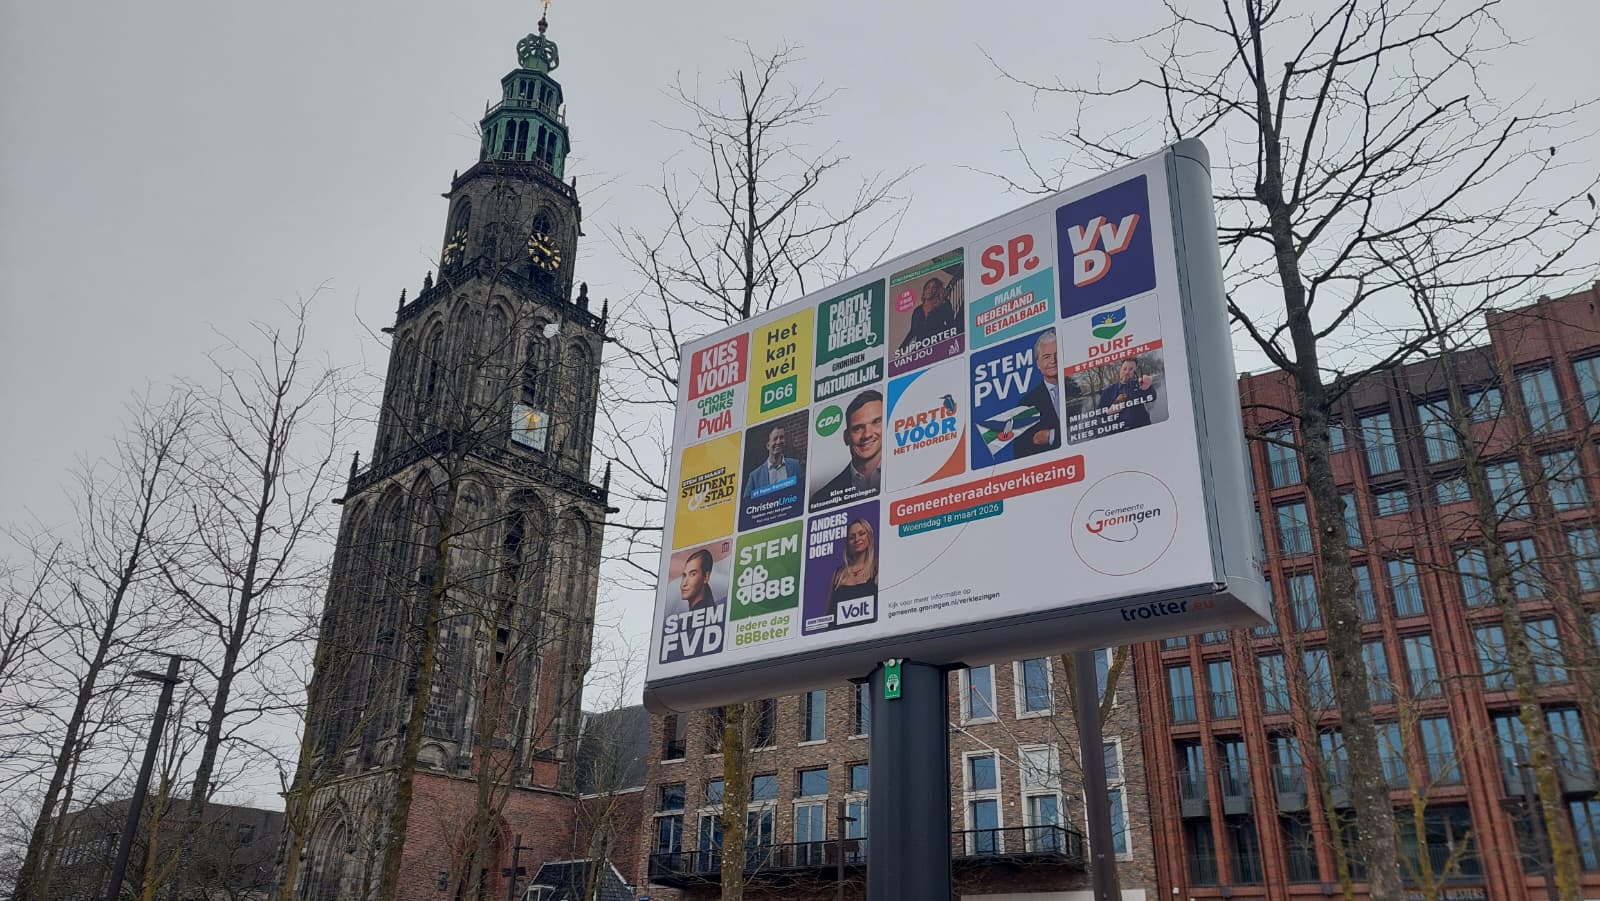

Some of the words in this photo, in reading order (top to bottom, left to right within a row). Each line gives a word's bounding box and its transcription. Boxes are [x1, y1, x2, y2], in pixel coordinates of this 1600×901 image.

[829, 289, 872, 321] PARTIJ
[994, 285, 1022, 306] MAAK
[829, 312, 856, 335] VOOR
[858, 306, 872, 324] DE
[976, 293, 1034, 325] NEDERLAND
[985, 301, 1046, 336] BETAALBAAR
[767, 323, 798, 345] Het
[827, 320, 872, 352] DIEREN
[894, 327, 957, 359] SUPPORTER
[1088, 334, 1134, 358] DURF
[701, 340, 738, 372] KIES
[766, 342, 796, 363] kan
[832, 353, 865, 372] GRONINGEN
[894, 356, 913, 368] VAN
[914, 347, 933, 361] JOU
[1074, 344, 1151, 373] STEMDURF.NL
[764, 356, 795, 380] wél
[974, 348, 1033, 382] STEM
[697, 361, 739, 394] VOOR
[816, 365, 880, 398] NATUURLIJK.
[974, 367, 1034, 408] PVV
[697, 388, 734, 409] GROEN
[764, 383, 793, 405] D66
[702, 400, 733, 417] LINKS
[817, 413, 841, 428] CDA
[894, 402, 958, 433] PARTIJ
[1069, 406, 1110, 423] MINDER
[1110, 394, 1154, 412] REGELS
[697, 409, 732, 439] PvdA
[1070, 419, 1098, 432] MEER
[1101, 412, 1120, 424] LEF
[1070, 429, 1094, 442] KIES
[1097, 421, 1125, 435] DURF
[893, 444, 912, 456] HET
[912, 432, 957, 451] NOORDEN
[681, 473, 735, 498] STUDENT
[704, 485, 735, 503] STAD
[830, 489, 843, 497] Kies
[896, 463, 1077, 518] Gemeenteraadsverkiezing
[746, 494, 798, 515] ChristenUnie
[1104, 503, 1144, 517] Gemeente
[810, 511, 848, 533] ANDERS
[902, 518, 941, 533] Woensdag
[943, 514, 953, 524] 18
[954, 508, 977, 521] maart
[978, 503, 999, 515] 2026
[1086, 508, 1161, 534] Groningen
[810, 525, 848, 546] DURVEN
[739, 534, 798, 566] STEM
[809, 542, 834, 560] DOEN
[913, 595, 929, 604] meer
[930, 590, 962, 601] informatie
[962, 588, 972, 596] op
[664, 603, 725, 634] STEM
[841, 601, 870, 619] Volt
[736, 619, 768, 633] Iedere
[770, 615, 790, 627] dag
[661, 624, 723, 661] FVD
[735, 627, 790, 646] BBBeter
